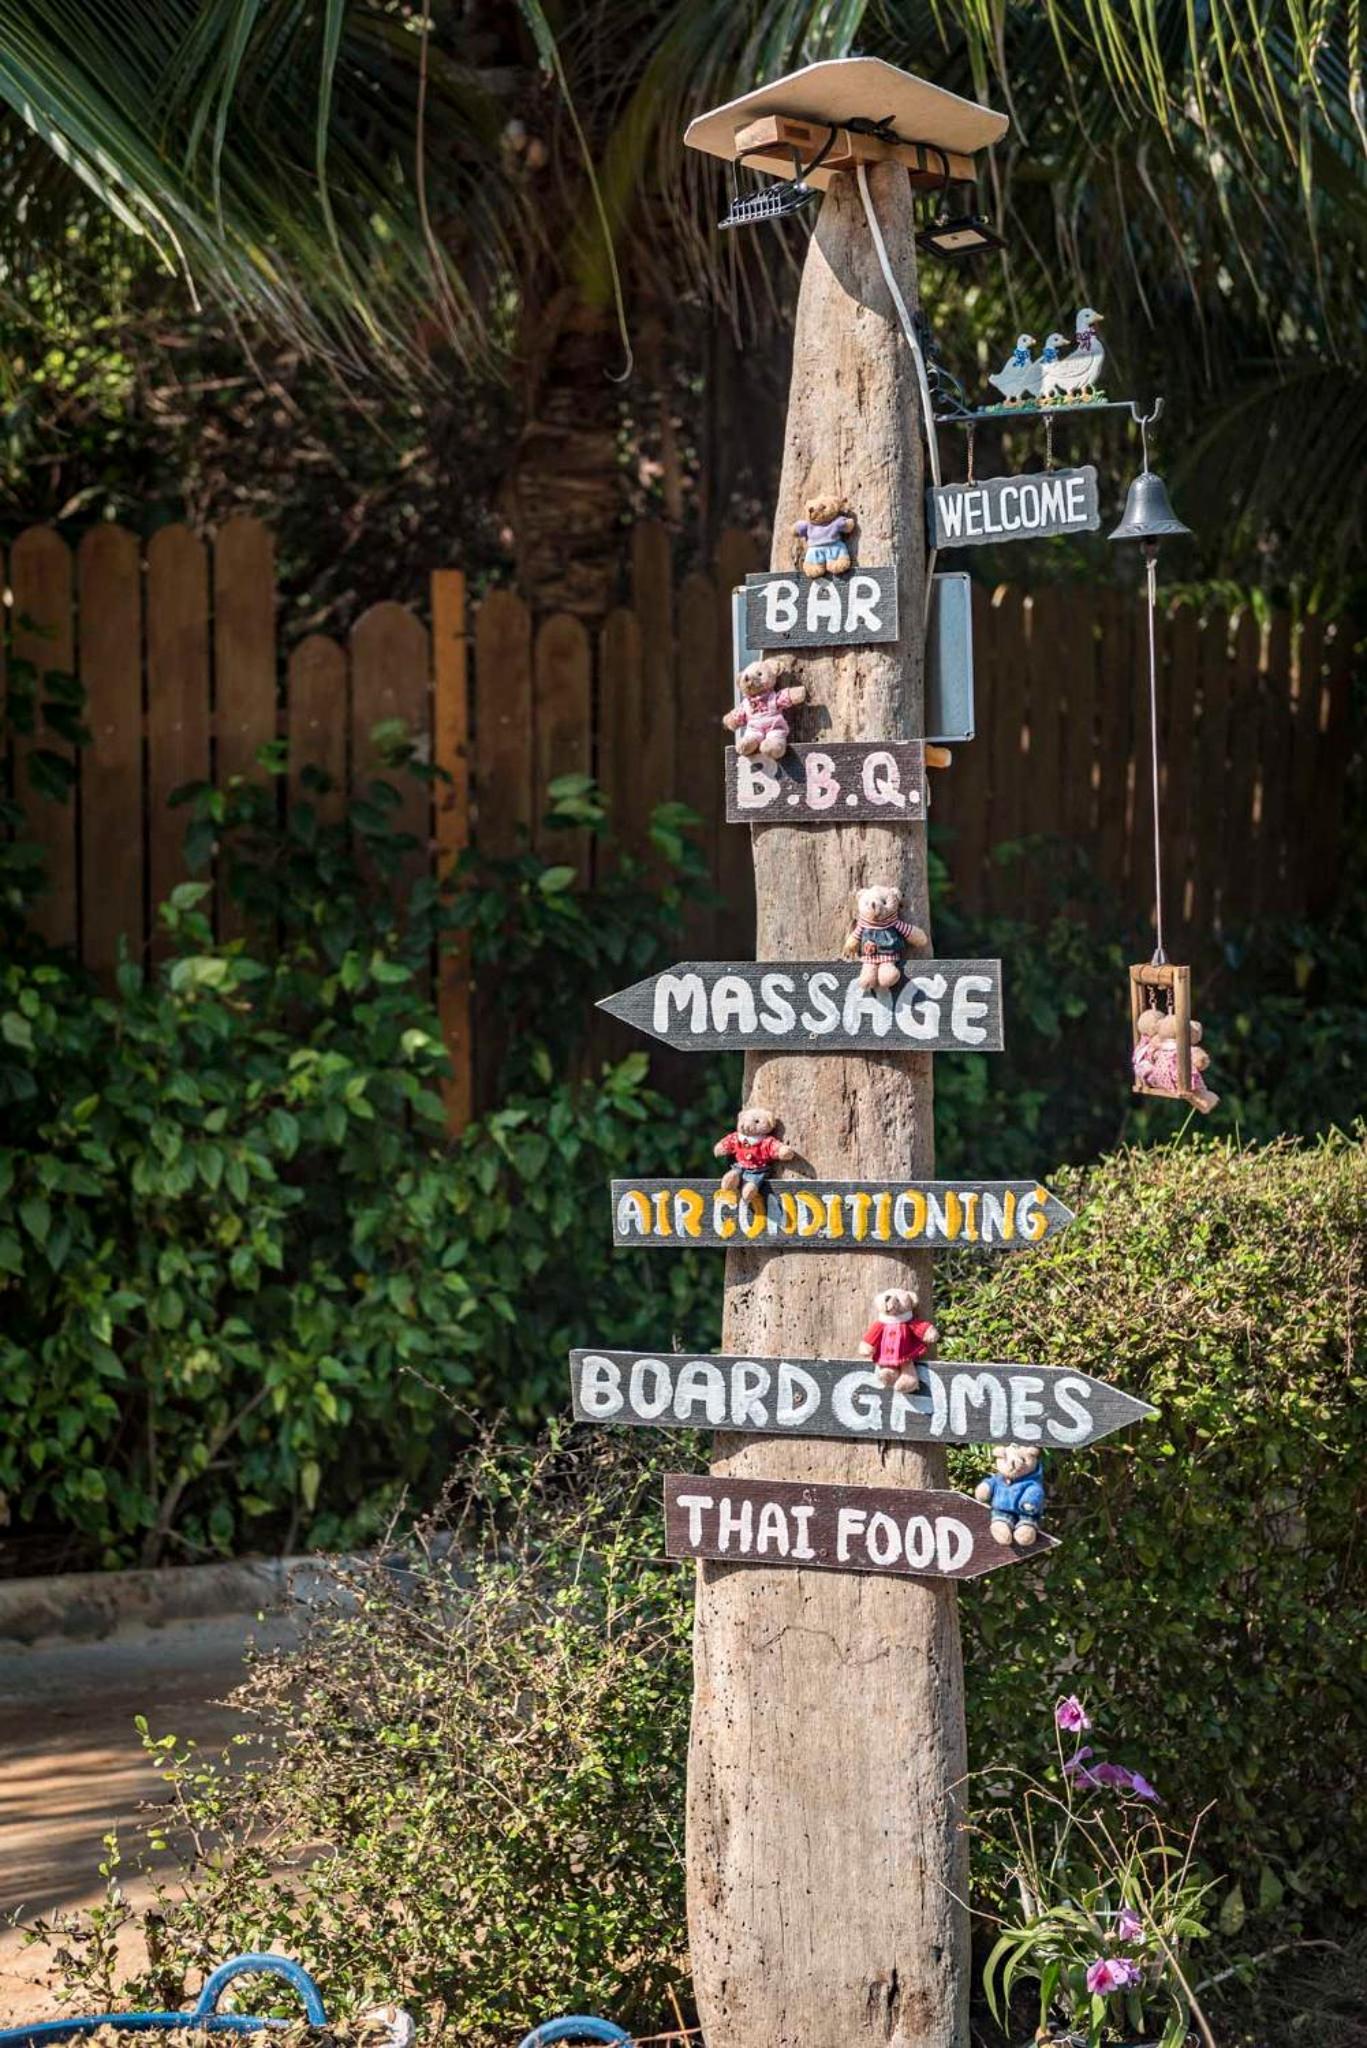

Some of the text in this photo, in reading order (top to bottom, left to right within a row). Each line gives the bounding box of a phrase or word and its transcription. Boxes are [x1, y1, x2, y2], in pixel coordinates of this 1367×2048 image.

[938, 476, 1088, 538] WELCOME
[762, 576, 883, 634] BAR
[736, 750, 922, 811] B.B.Q.
[652, 971, 994, 1046] MASSAGE
[616, 1187, 1049, 1243] AIR CONDITIONING
[580, 1355, 1094, 1445] BOARD GAMES
[676, 1494, 974, 1572] THAI FOOD
